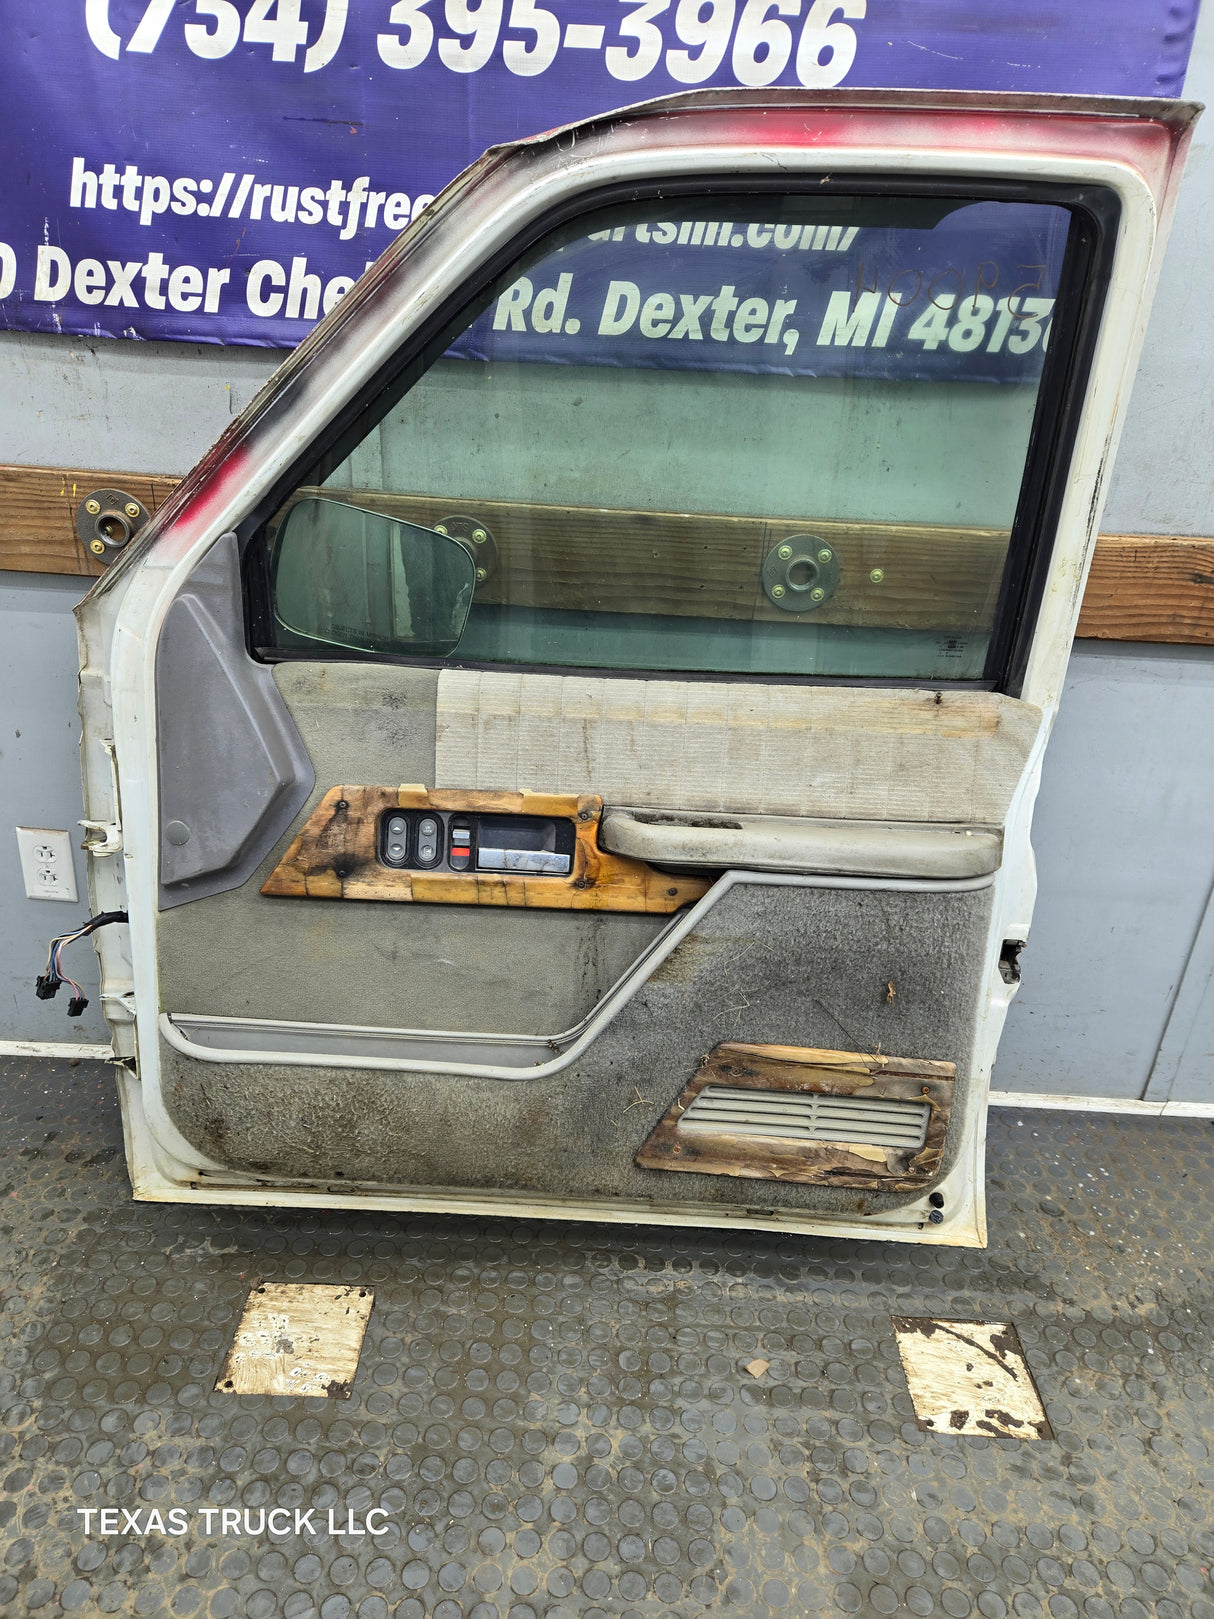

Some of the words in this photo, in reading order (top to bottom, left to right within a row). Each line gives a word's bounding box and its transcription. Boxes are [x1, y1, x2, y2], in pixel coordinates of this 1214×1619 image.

[376, 0, 867, 88] 395-3966
[34, 245, 230, 313] Dexter
[492, 272, 581, 335] Rd.
[597, 280, 798, 355] Dexter,
[816, 290, 902, 347] MI
